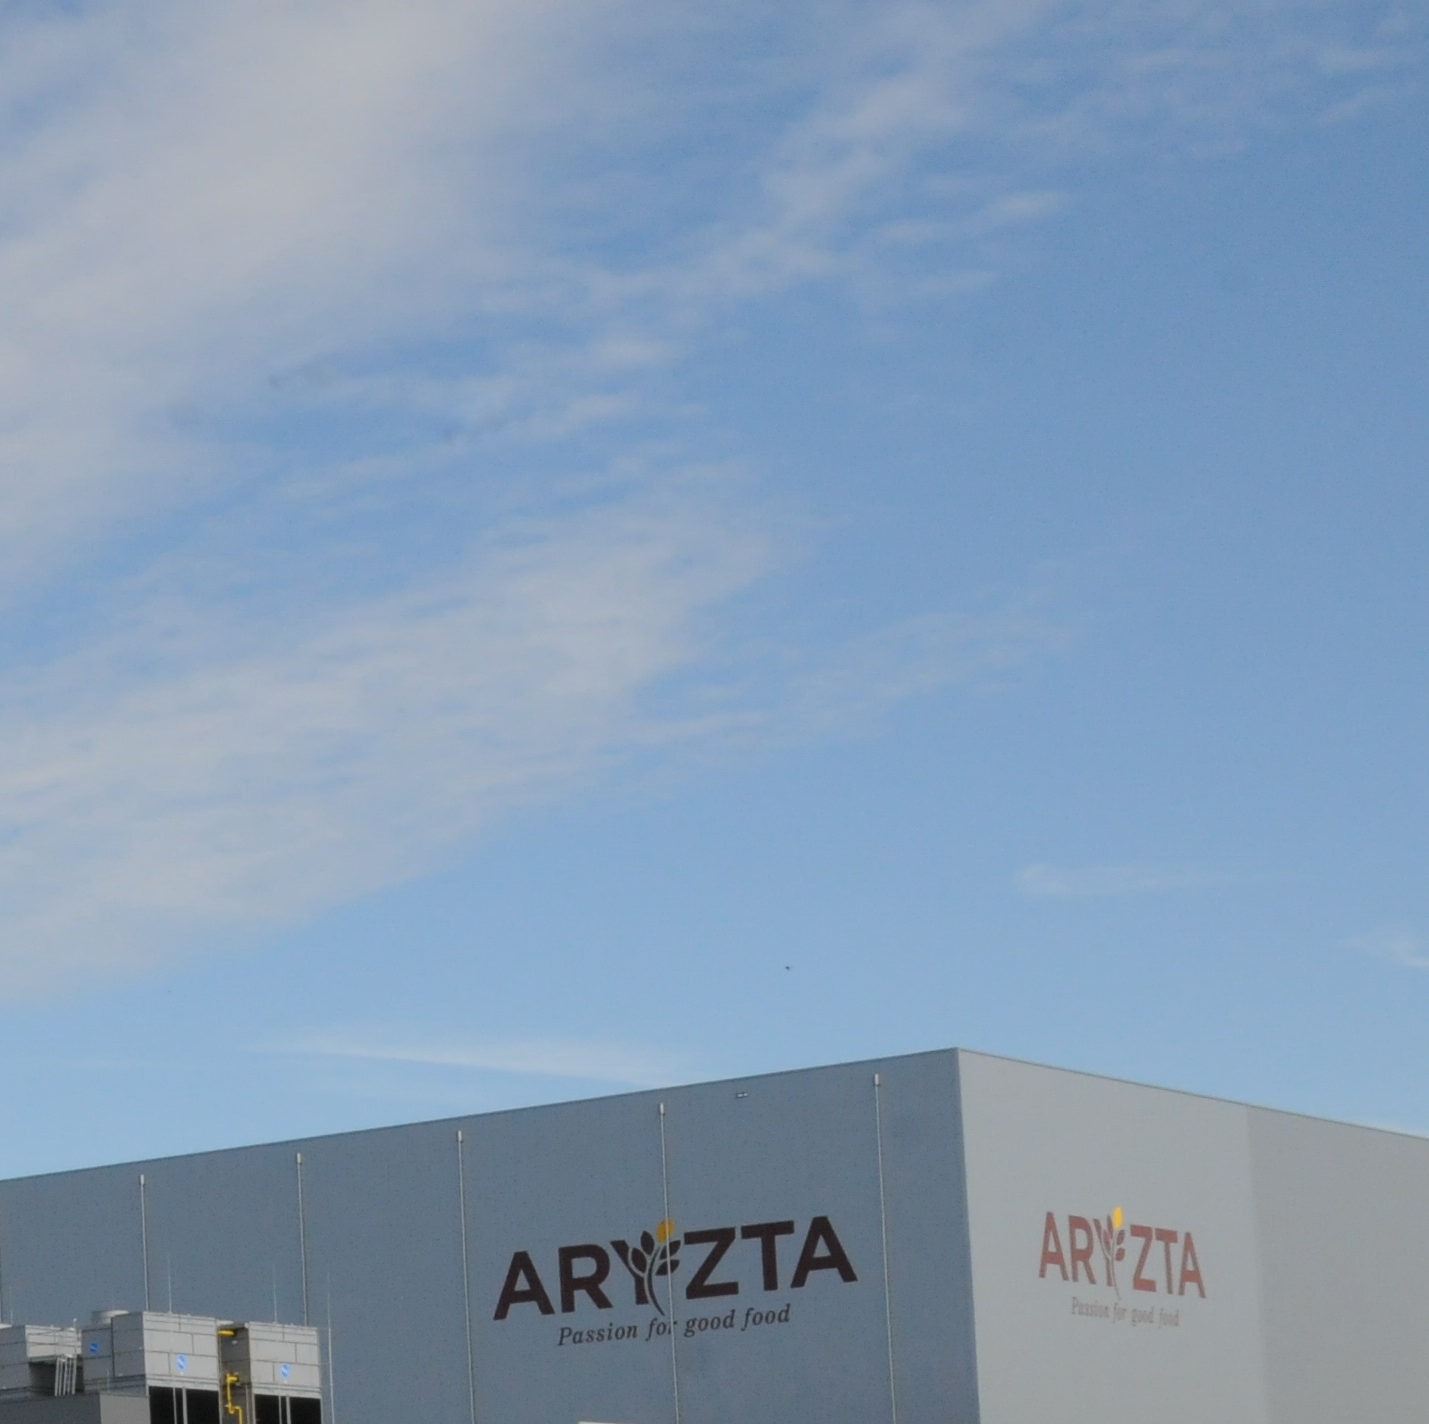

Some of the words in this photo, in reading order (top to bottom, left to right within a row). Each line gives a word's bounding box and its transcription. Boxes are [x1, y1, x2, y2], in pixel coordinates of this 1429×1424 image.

[492, 1215, 859, 1321] ARYZTA
[1039, 1211, 1206, 1299] ARYZTA
[557, 1321, 638, 1346] Passion
[645, 1317, 677, 1342] for
[683, 1309, 736, 1338] good
[741, 1303, 791, 1332] food
